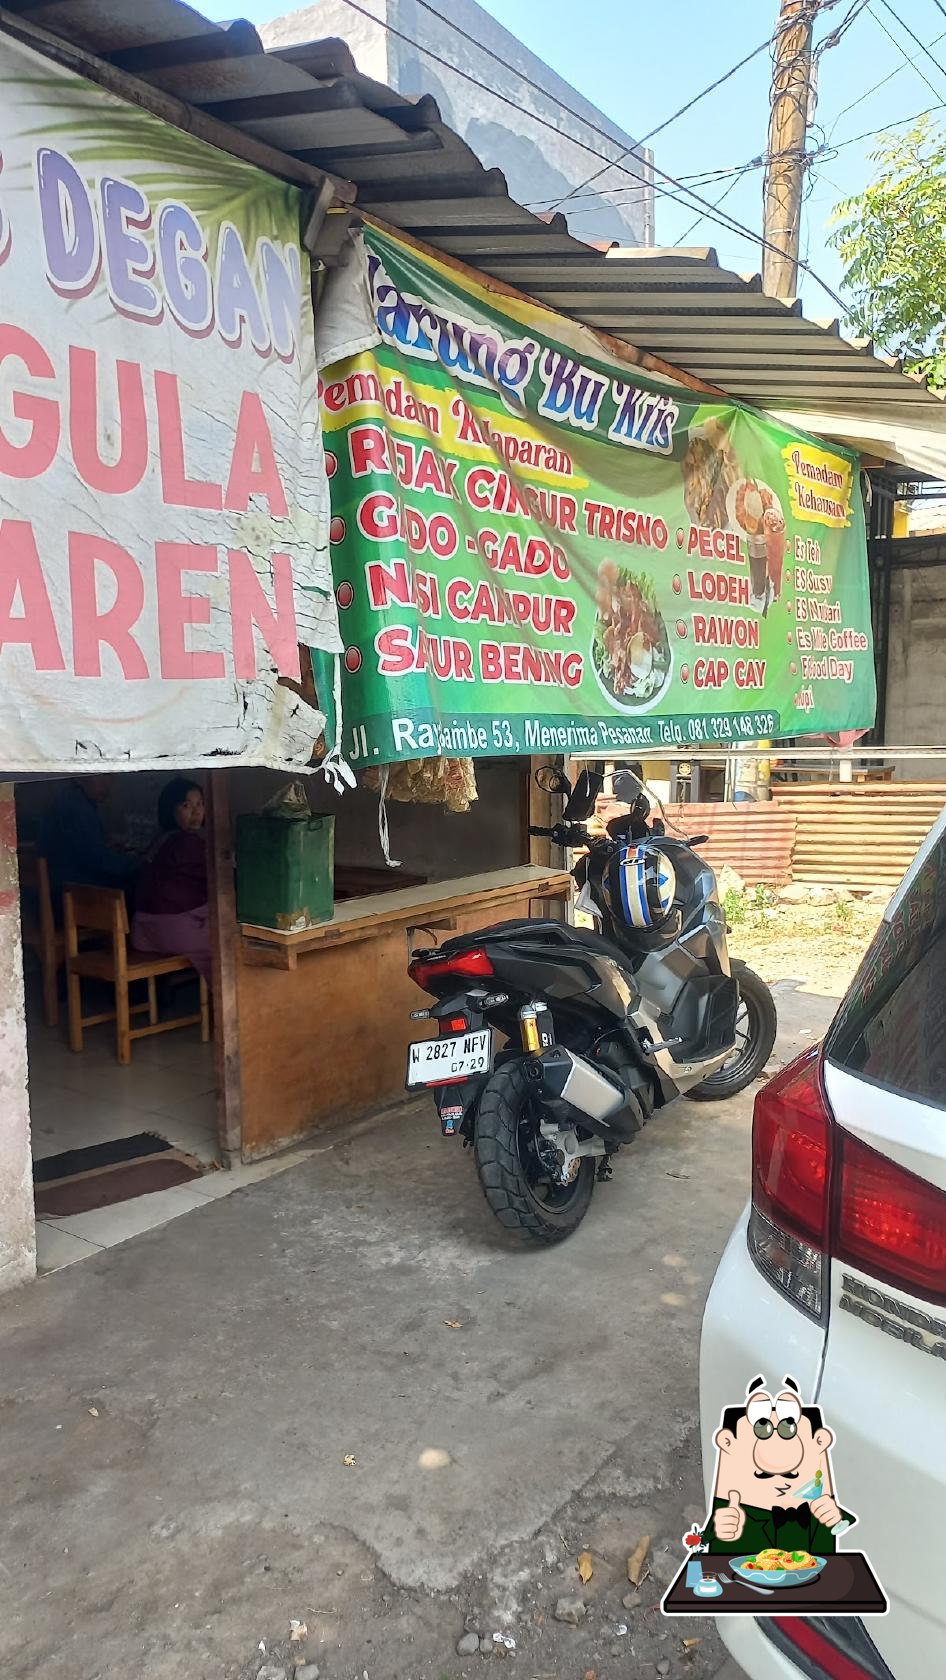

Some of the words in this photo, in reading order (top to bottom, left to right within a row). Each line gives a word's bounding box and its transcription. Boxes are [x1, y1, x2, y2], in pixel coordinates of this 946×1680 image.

[36, 146, 300, 364] DEGAN
[367, 254, 536, 413] arung
[0, 323, 288, 517] GULA
[791, 450, 843, 489] Pemadam
[359, 494, 458, 557] GDO
[584, 501, 668, 549] TRISNO
[687, 528, 745, 563] PECEL
[0, 518, 300, 681] AREN
[367, 561, 440, 616] NSI
[687, 571, 750, 605] LODEH
[693, 616, 759, 647] RAWON
[830, 629, 867, 649] Coffee
[693, 660, 729, 689] CAP
[733, 660, 767, 689] CAY
[829, 657, 852, 681] Day
[349, 724, 379, 760] Jl.
[525, 719, 599, 747] Menerima
[597, 721, 653, 744] Pesanan
[688, 718, 709, 740] 081
[711, 717, 733, 739] 329
[733, 716, 754, 736] 148
[412, 1048, 421, 1064] W
[426, 1041, 457, 1061] 2827
[463, 1034, 487, 1054] NFV
